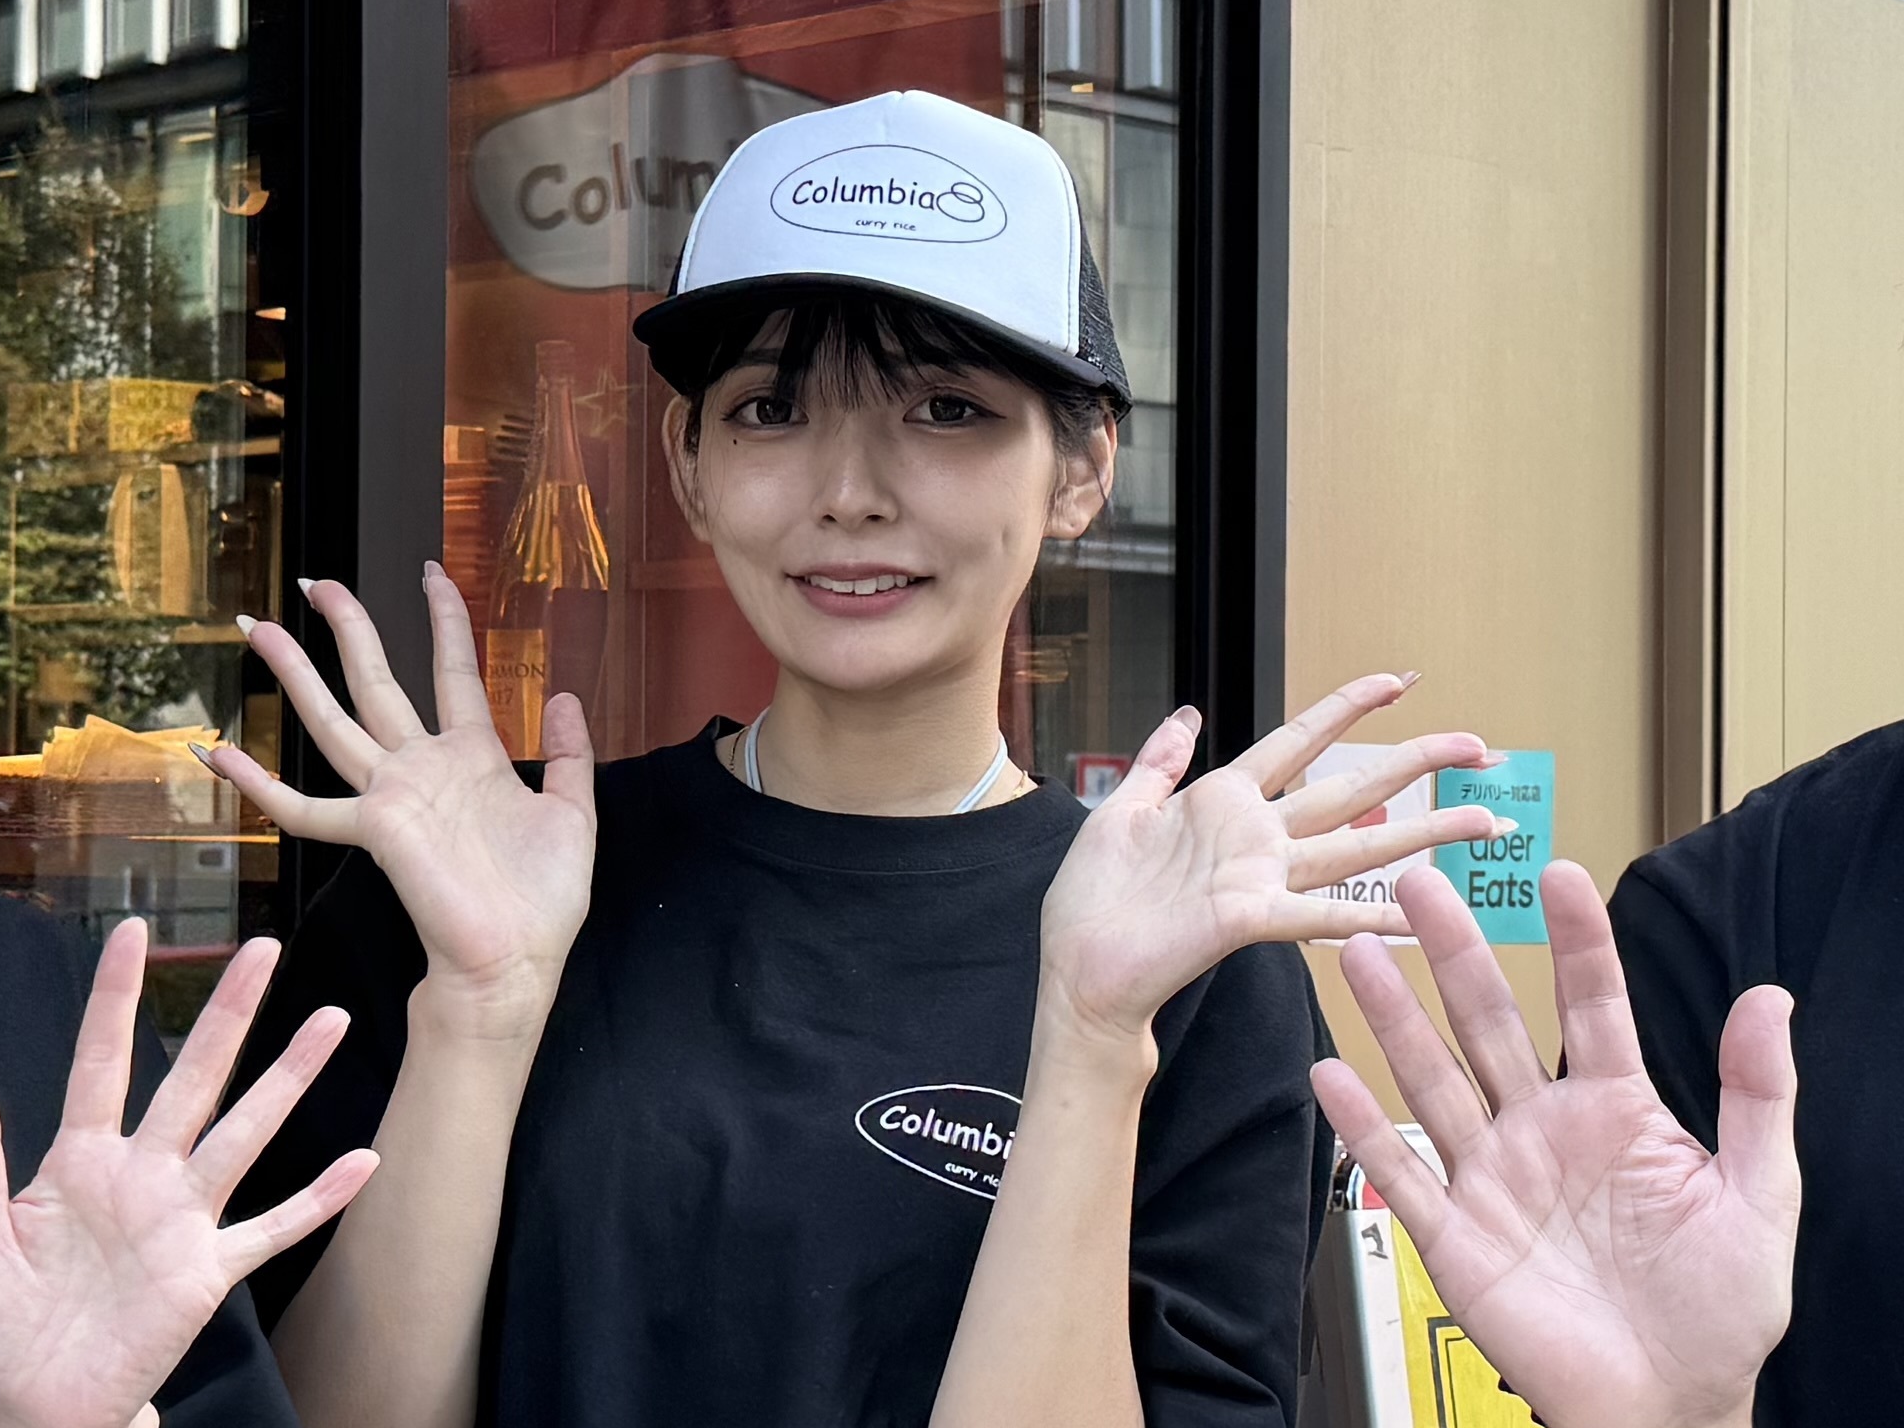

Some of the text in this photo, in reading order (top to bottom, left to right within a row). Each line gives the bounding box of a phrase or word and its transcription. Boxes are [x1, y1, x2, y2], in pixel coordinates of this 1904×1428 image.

[516, 138, 741, 230] Colum
[791, 175, 935, 211] Columbia
[855, 218, 917, 232] curry rice
[1468, 870, 1534, 909] Eats
[878, 1104, 1017, 1160] Columbi
[944, 1161, 1002, 1187] curry ric
